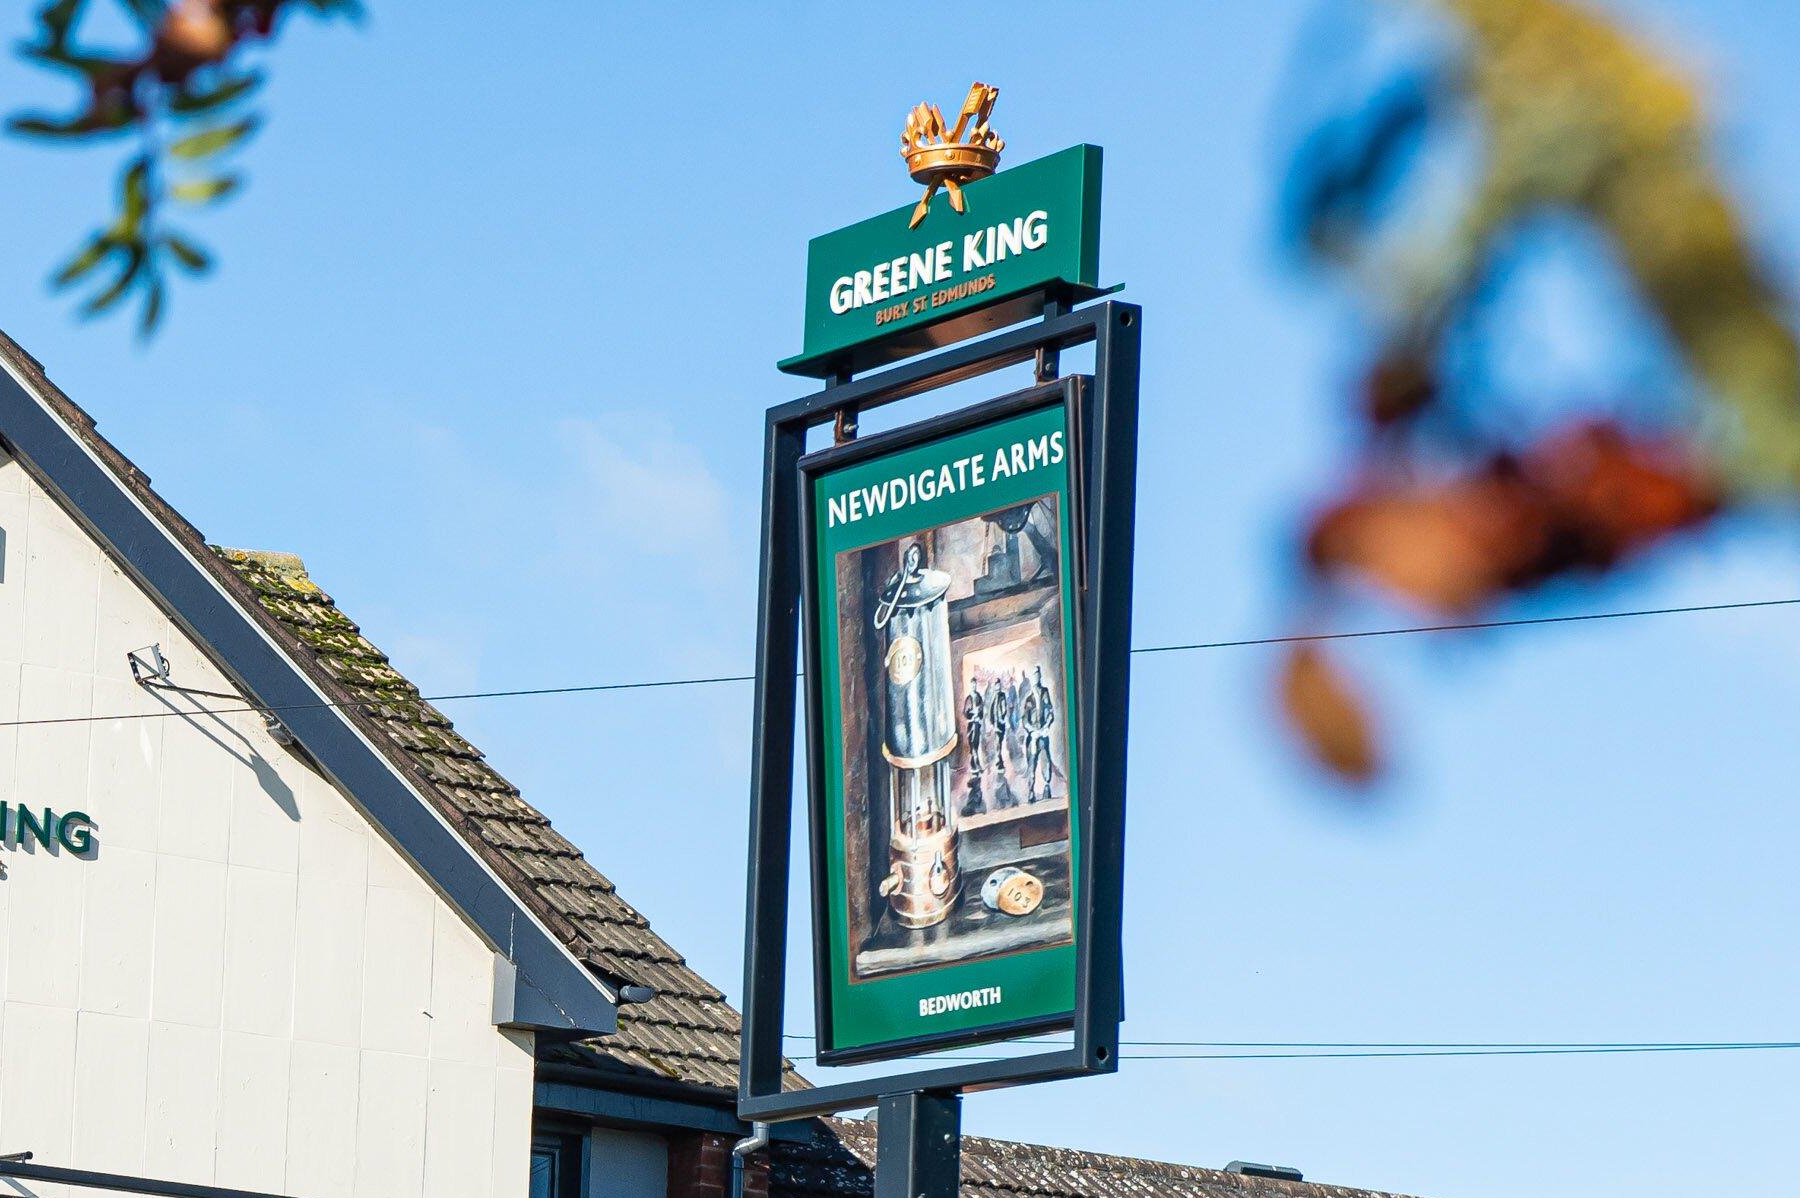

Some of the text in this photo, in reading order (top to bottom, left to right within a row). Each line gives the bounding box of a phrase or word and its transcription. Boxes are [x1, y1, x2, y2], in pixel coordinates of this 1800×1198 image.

[829, 210, 1048, 316] GREENE KING
[875, 274, 996, 326] BURY ST EDMUNDS
[827, 431, 1064, 528] NEWDIGATE ARMS
[919, 986, 1001, 1017] BEDWORTH
